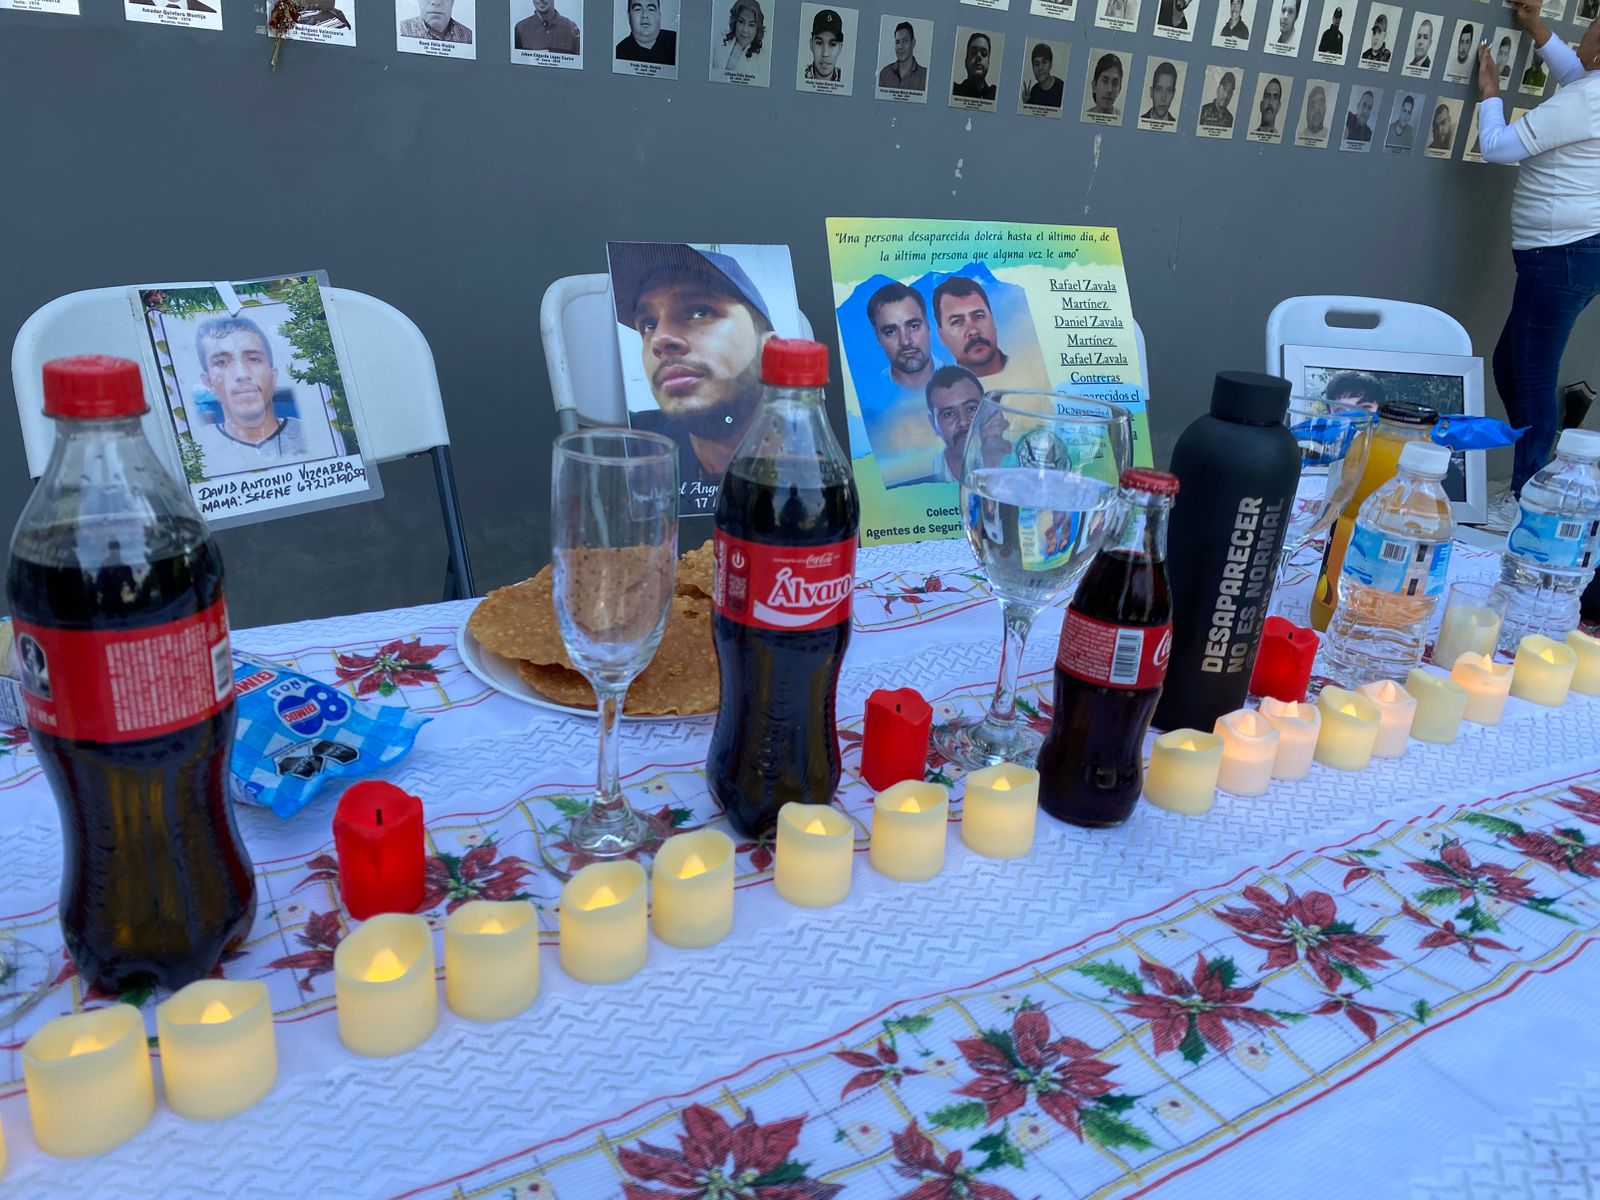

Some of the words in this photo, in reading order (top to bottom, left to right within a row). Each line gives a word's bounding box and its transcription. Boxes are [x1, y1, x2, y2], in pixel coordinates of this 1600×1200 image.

[864, 233, 904, 248] persona
[908, 230, 970, 246] desaparecida
[974, 230, 1003, 241] dolerá
[1007, 230, 1032, 241] hasta
[1036, 231, 1044, 241] el
[1048, 231, 1076, 242] último
[1100, 231, 1110, 242] de
[880, 250, 890, 262] la
[894, 249, 926, 261] última
[931, 251, 968, 265] persona
[972, 250, 989, 265] que
[993, 248, 1024, 264] alguna
[1028, 250, 1043, 259] vez
[1047, 248, 1054, 259] le
[1049, 278, 1081, 291] Rafael
[1082, 279, 1117, 292] Zavala
[1061, 296, 1109, 309] Martínez
[1054, 315, 1088, 327] Daniel
[1089, 315, 1124, 328] Zavala
[1067, 333, 1115, 346] Martínez
[1060, 352, 1092, 364] Rafael
[1094, 352, 1128, 364] Zavala
[1070, 371, 1121, 383] Contreras
[1131, 389, 1139, 401] el
[198, 481, 238, 501] DAVID
[241, 472, 293, 493] ANTONIO
[299, 461, 354, 481] VIZCARRA
[245, 485, 291, 504] SELENE
[694, 497, 708, 508] 17
[926, 506, 961, 517] Colecti
[866, 526, 911, 540] Agentes
[912, 524, 926, 535] de
[928, 521, 964, 535] Seguri
[1244, 498, 1284, 598] NORMAL
[1201, 497, 1263, 673] DESAPARECER
[1236, 607, 1257, 635] ES
[1226, 642, 1249, 673] NO
[233, 670, 276, 696] BIM
[282, 703, 317, 723] BIMBO
